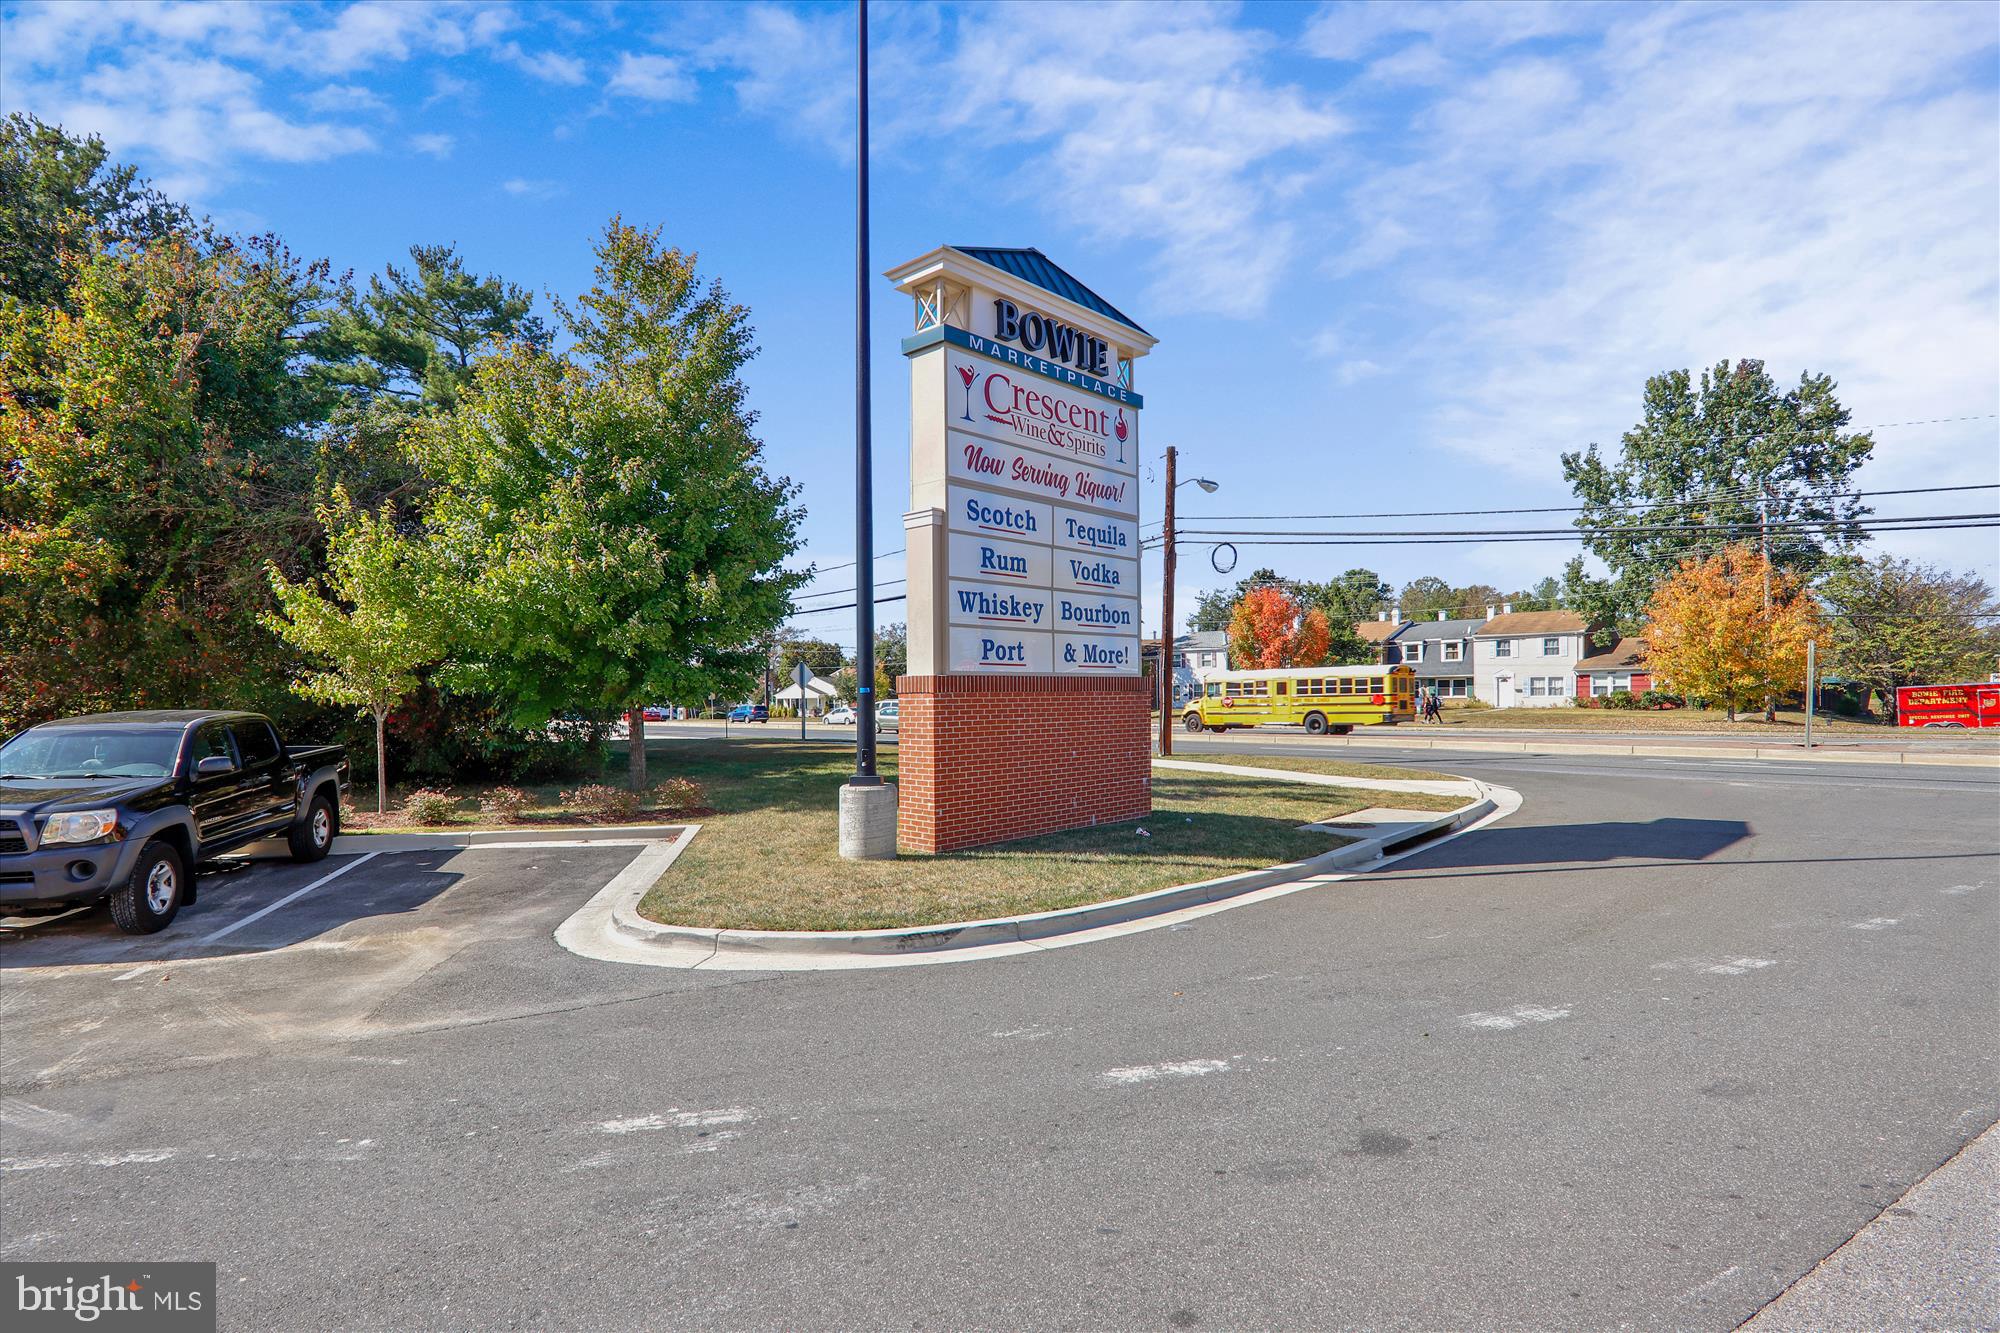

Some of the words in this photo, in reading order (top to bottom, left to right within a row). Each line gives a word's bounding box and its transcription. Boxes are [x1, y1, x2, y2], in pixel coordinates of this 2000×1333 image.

[993, 298, 1109, 378] BOWIE
[969, 335, 1128, 402] MARKETPLACE
[983, 373, 1110, 437] Crescent
[1010, 414, 1047, 441] Wine
[1066, 431, 1106, 458] Spirits
[964, 444, 1005, 476] Now
[1011, 456, 1070, 498] Serving
[1075, 471, 1125, 503] Liquor!
[966, 498, 1037, 532] Scotch
[1065, 518, 1127, 547] Tequila
[980, 547, 1028, 574] Rum
[1069, 559, 1120, 585] Vodka
[957, 590, 1044, 624] Whiskey
[1060, 600, 1131, 625] Bourbon
[981, 639, 1025, 662] Port
[1063, 643, 1077, 663] &
[1083, 643, 1129, 664] More!
[1908, 697, 1968, 705] DEPARTMENT
